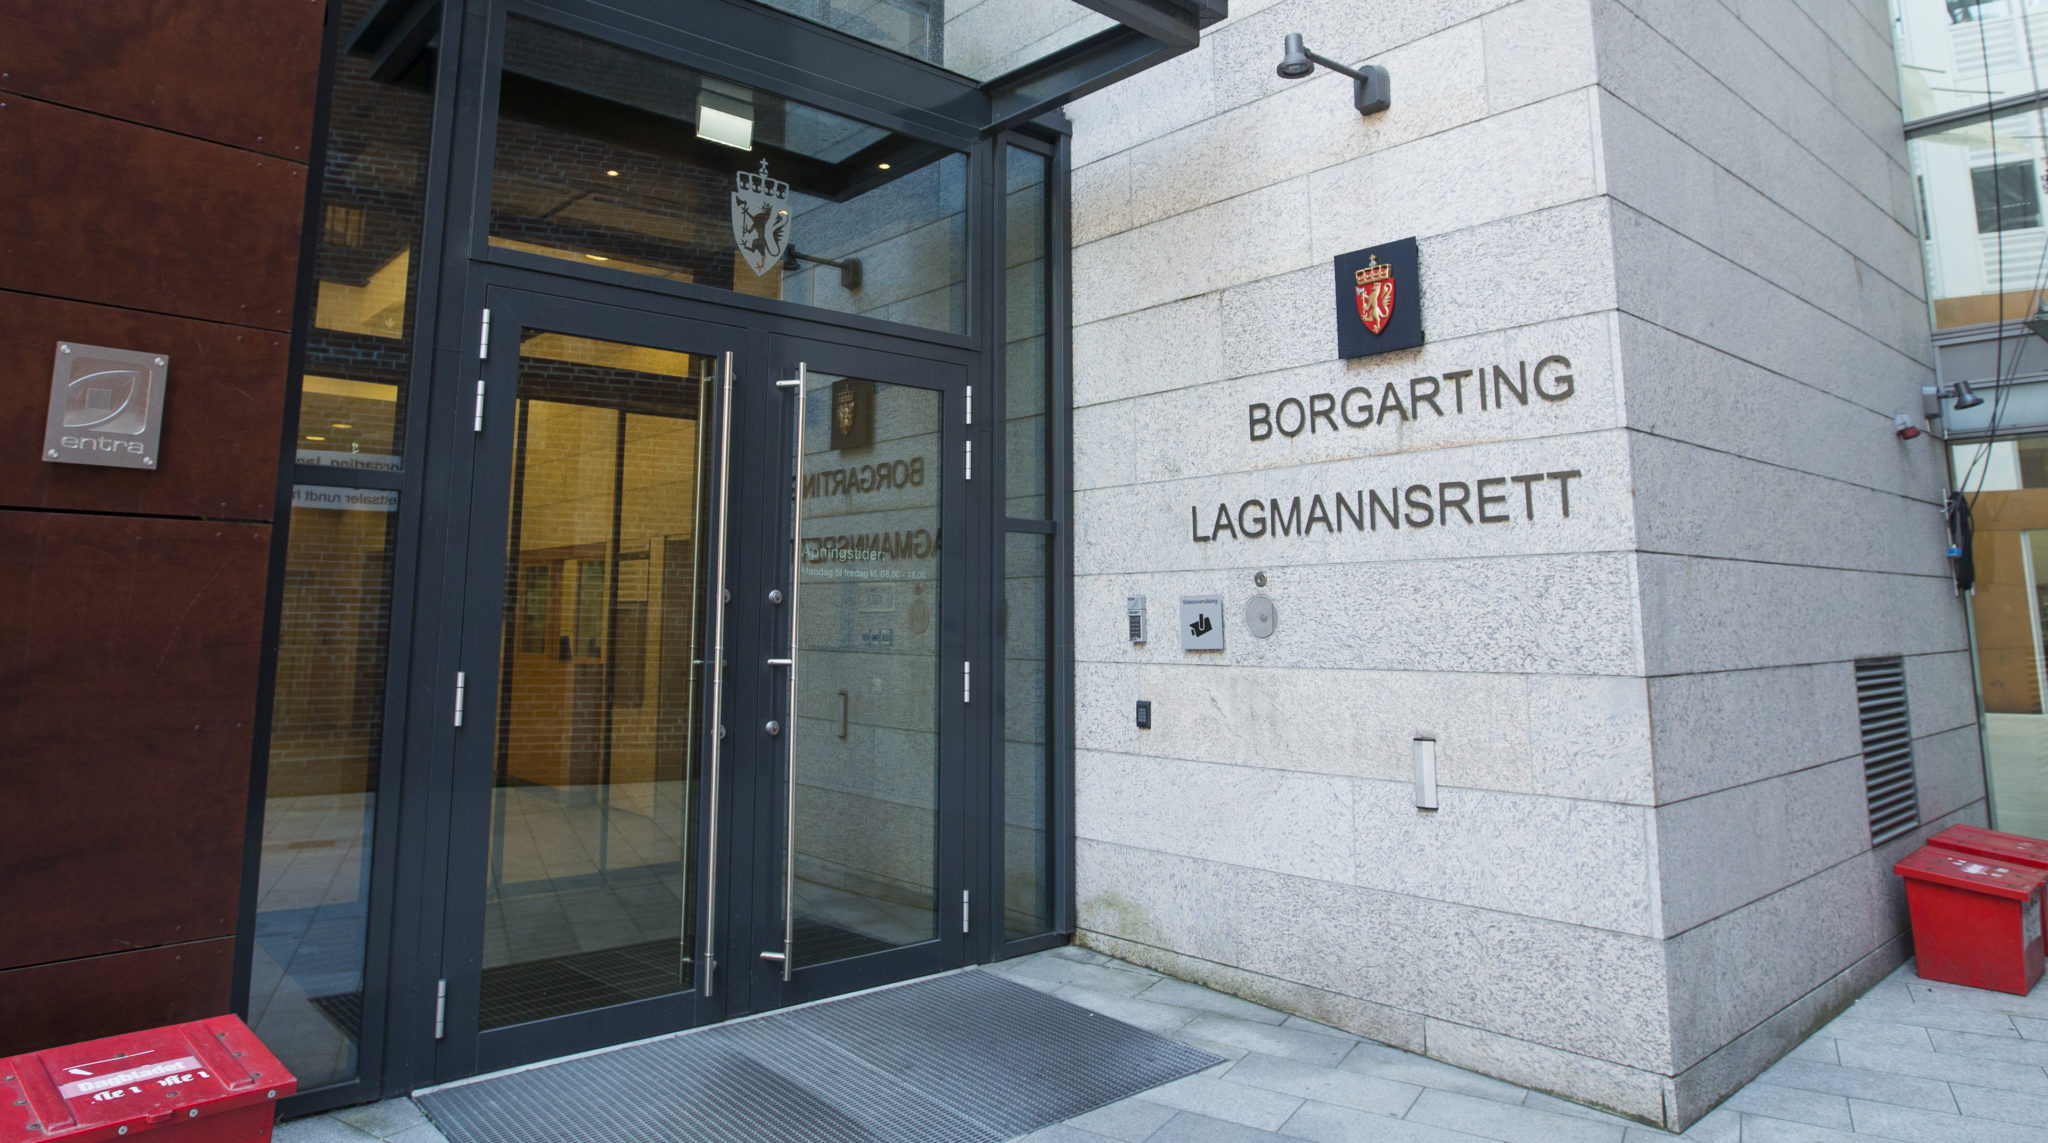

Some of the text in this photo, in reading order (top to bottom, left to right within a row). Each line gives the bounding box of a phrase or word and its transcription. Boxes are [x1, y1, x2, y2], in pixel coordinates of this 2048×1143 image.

[1248, 355, 1574, 442] BORGARTING
[61, 436, 145, 454] entra
[1192, 469, 1582, 542] LAGMANNSRETT
